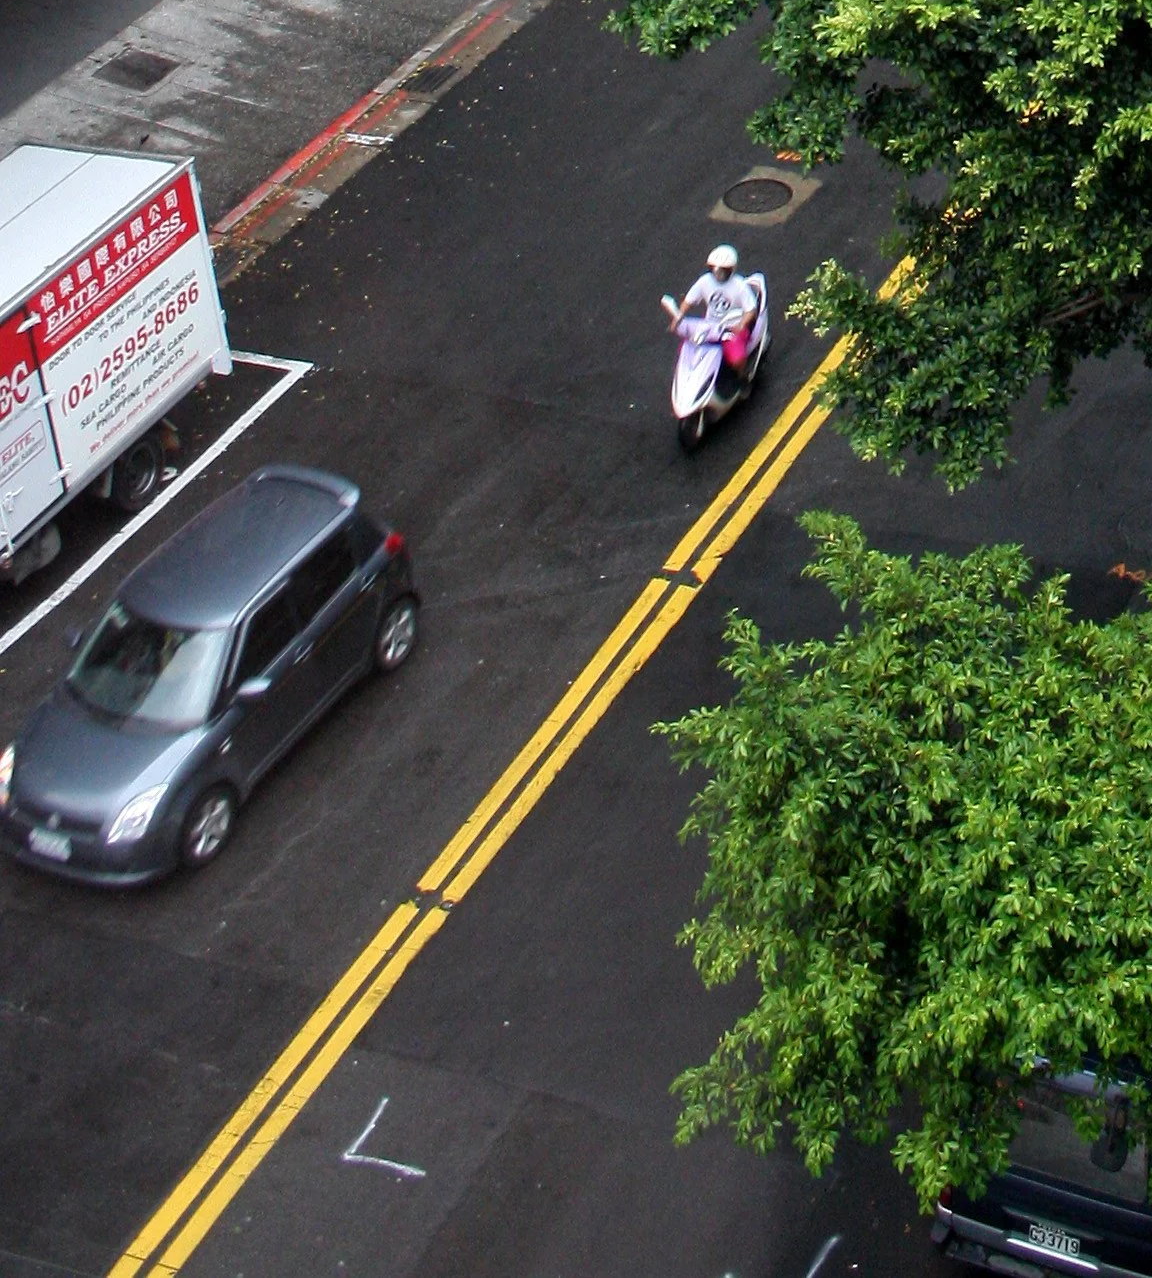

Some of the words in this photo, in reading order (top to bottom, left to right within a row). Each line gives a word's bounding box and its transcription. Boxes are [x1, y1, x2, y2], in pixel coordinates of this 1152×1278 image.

[45, 278, 98, 333] ELITE
[103, 208, 181, 285] EXPRESS
[142, 301, 156, 319] AND
[159, 269, 195, 304] INDONESIA
[48, 346, 70, 370] DOOR
[72, 336, 81, 350] TO
[84, 317, 104, 340] DOOR
[107, 290, 137, 321] SERVICE
[99, 328, 108, 342] TO
[111, 314, 124, 331] THE
[126, 277, 169, 318] PHILIPPINES
[60, 281, 200, 415] (02)2595-8686
[110, 339, 161, 387] REMITTANCE
[152, 347, 166, 365] AIR
[168, 323, 193, 350] CARGO
[80, 409, 97, 429] SEA
[99, 383, 126, 412] CARGO
[96, 385, 141, 430] PHILIPPINE
[143, 347, 184, 388] PRODUCTS
